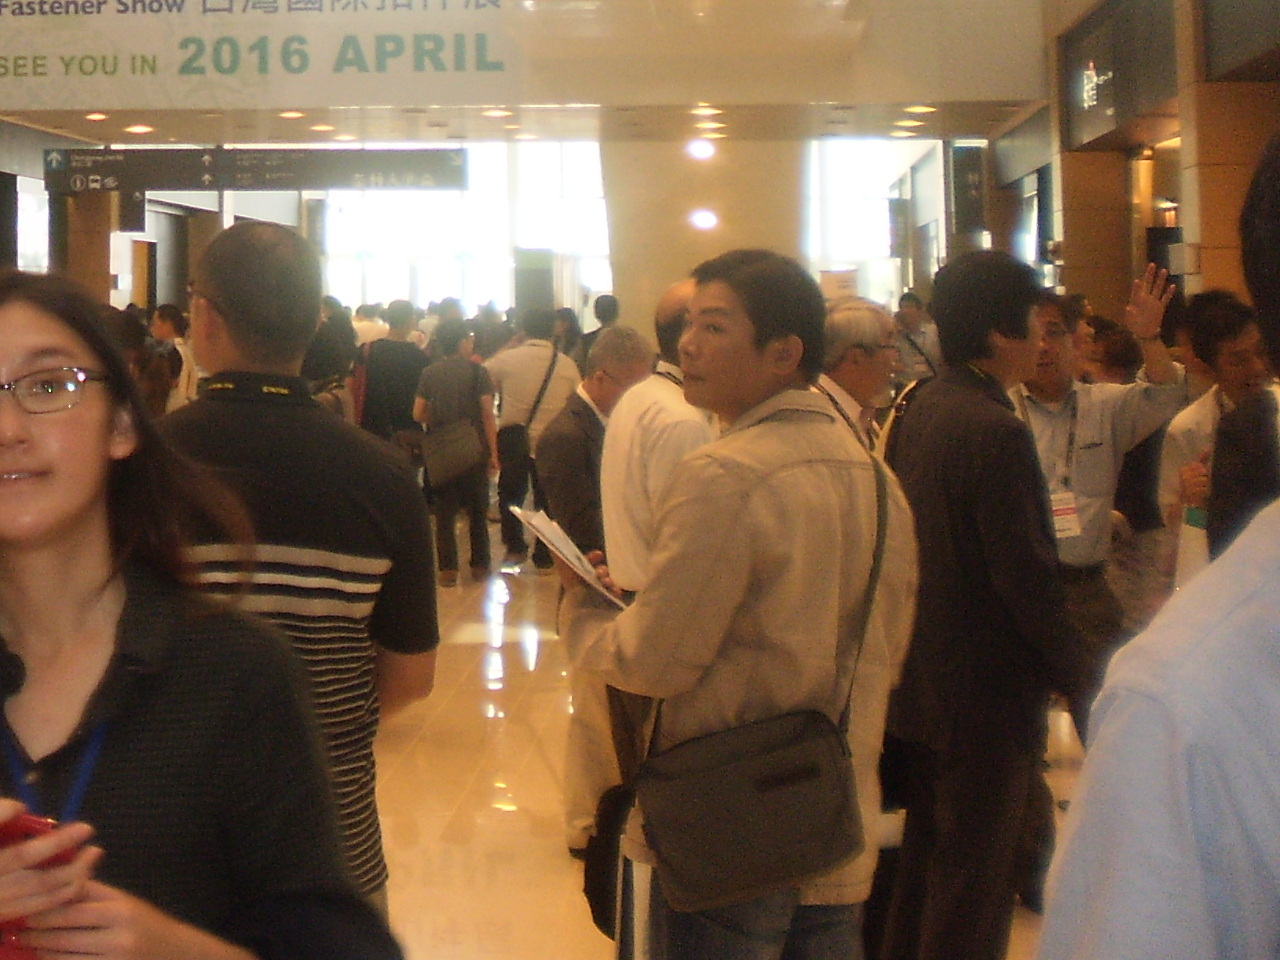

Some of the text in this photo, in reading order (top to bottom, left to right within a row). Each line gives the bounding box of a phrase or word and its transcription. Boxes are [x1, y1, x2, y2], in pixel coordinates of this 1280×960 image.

[60, 54, 119, 76] YOU
[131, 54, 158, 75] IN
[177, 34, 310, 76] 2016
[332, 32, 506, 74] APRIL
